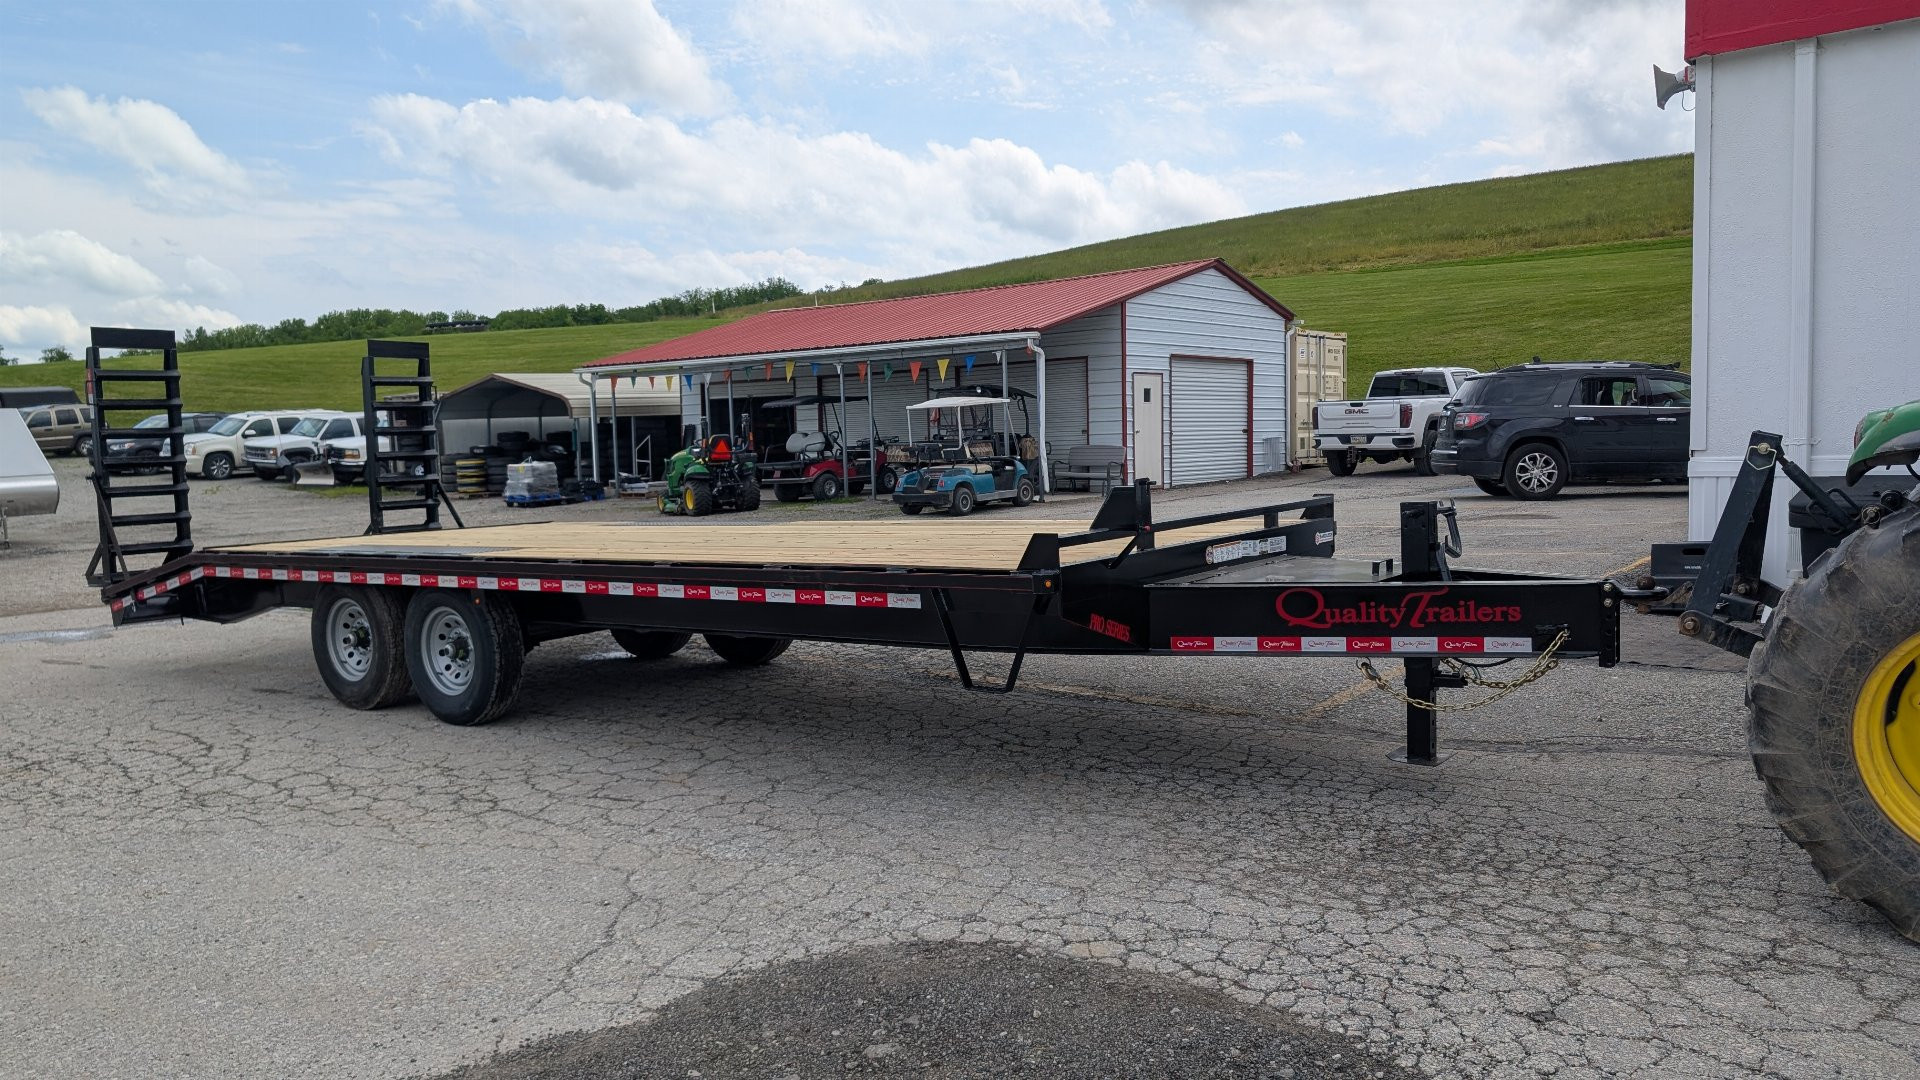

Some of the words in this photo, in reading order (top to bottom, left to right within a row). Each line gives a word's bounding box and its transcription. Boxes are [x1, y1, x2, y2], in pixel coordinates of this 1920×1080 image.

[1275, 587, 1405, 629] Quality
[1401, 586, 1522, 628] Trailers
[1105, 619, 1131, 642] SERIES
